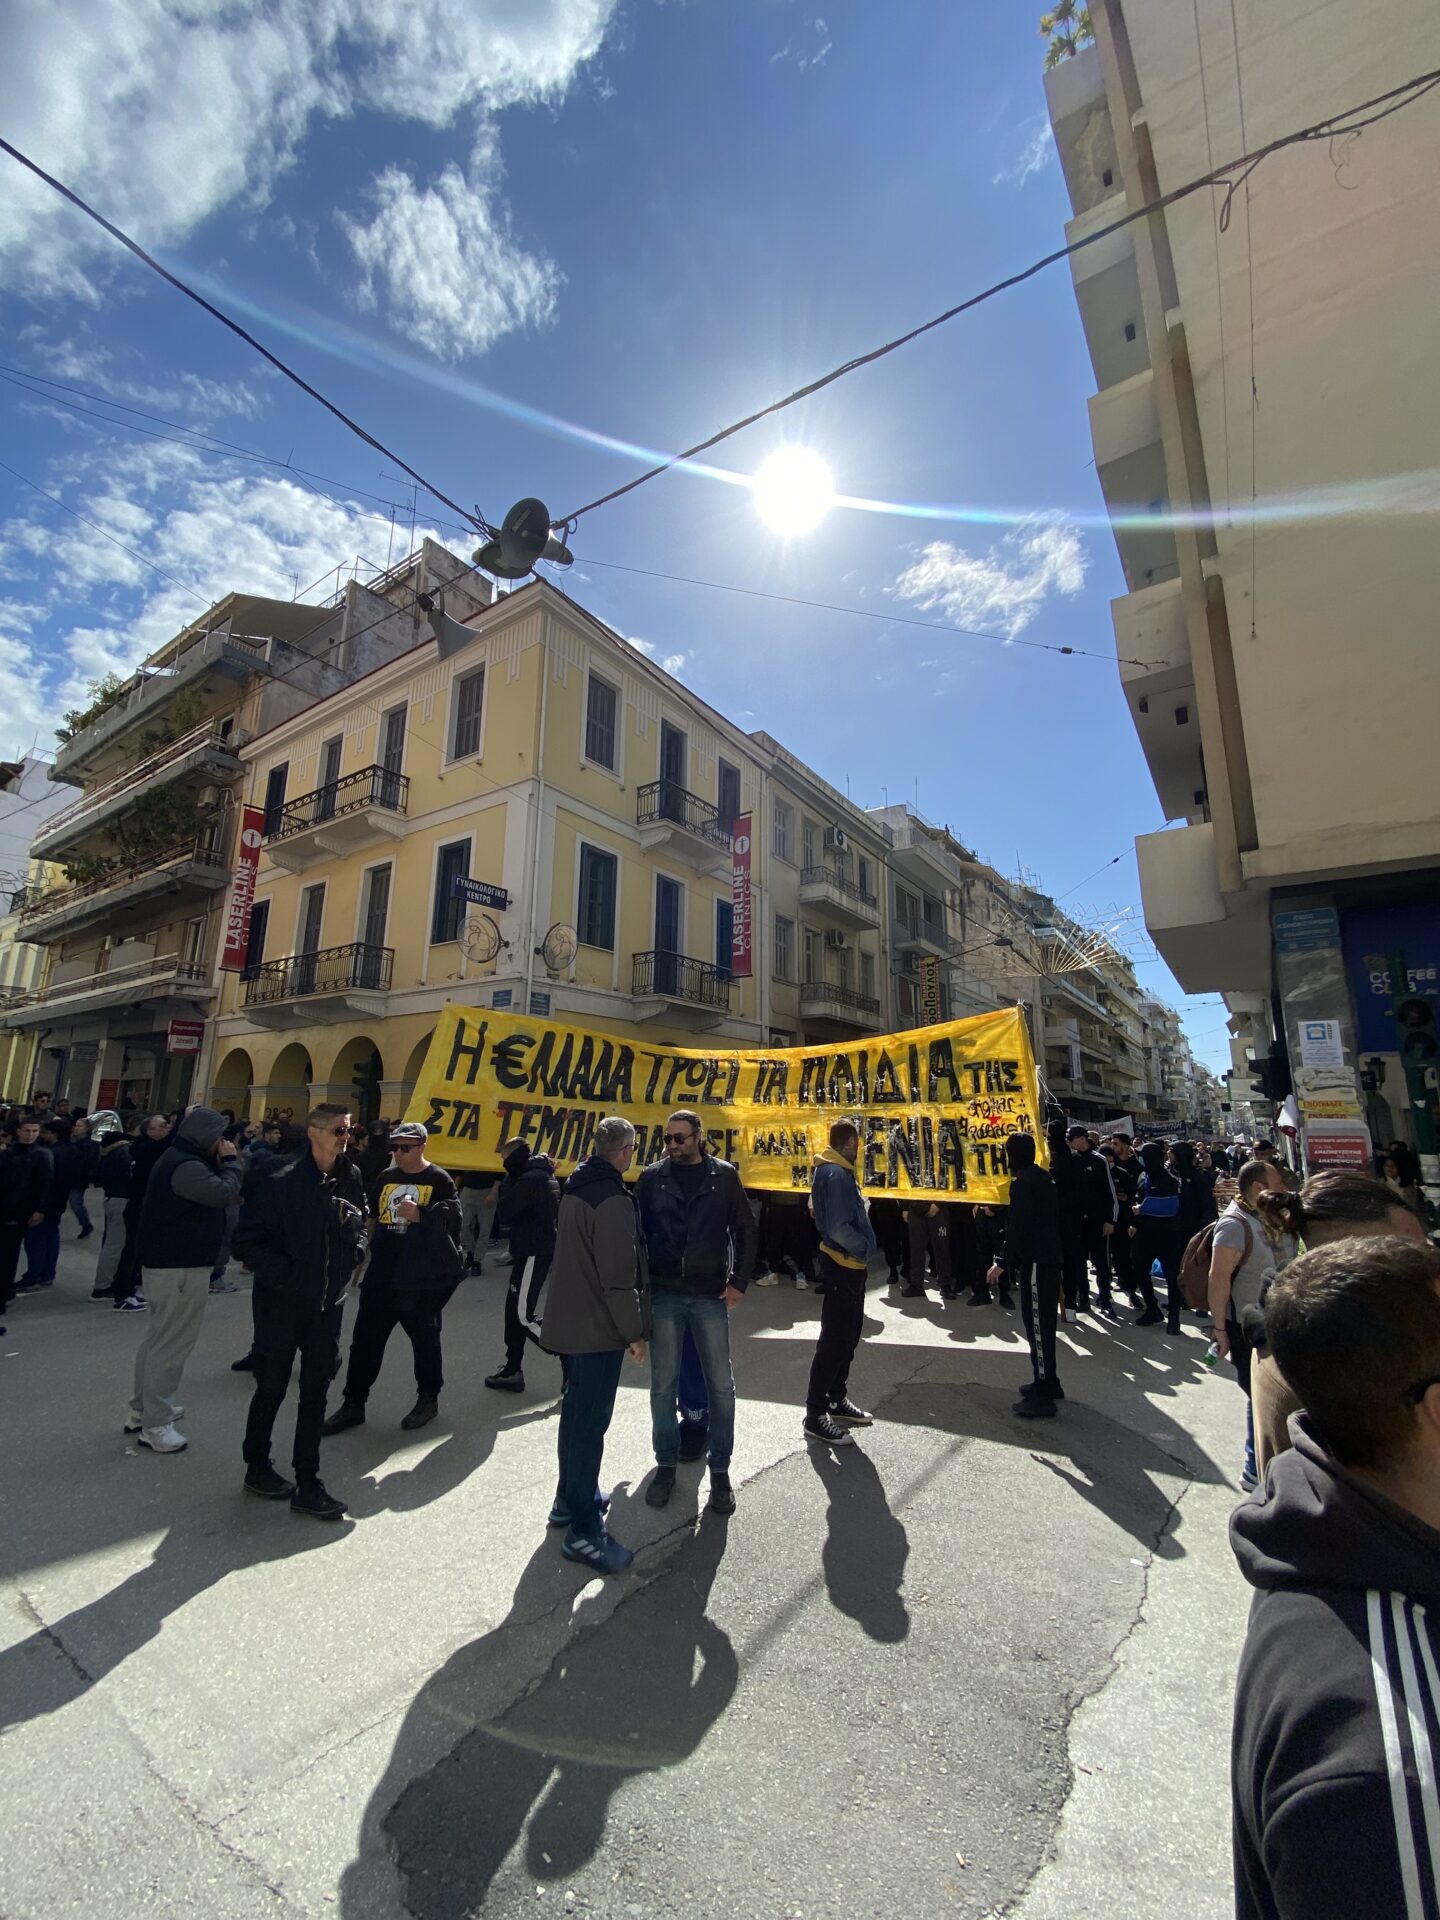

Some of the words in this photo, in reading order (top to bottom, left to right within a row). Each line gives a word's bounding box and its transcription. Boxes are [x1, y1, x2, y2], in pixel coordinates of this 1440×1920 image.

[225, 857, 251, 950] LASERLINE
[241, 866, 259, 946] CLINICS
[456, 877, 506, 899] ΓΥΝΑΙΚΟΛΟΓΙΚΟ
[466, 890, 491, 904] ΚΕΝΤΡΟ
[733, 865, 745, 956] LASERLINE
[744, 870, 752, 949] CLINICS
[1369, 968, 1438, 984] COFEE
[445, 1018, 489, 1085] Η
[746, 1058, 788, 1107] ΤΑ
[799, 1037, 963, 1105] ΠΑΙΔΙΑ
[963, 1060, 1023, 1094] ΤΗΣ
[424, 1097, 481, 1141] ΣΤΑ
[494, 1100, 606, 1163] ΤΕΜΠΗ
[967, 1143, 1010, 1175] ΤΗ
